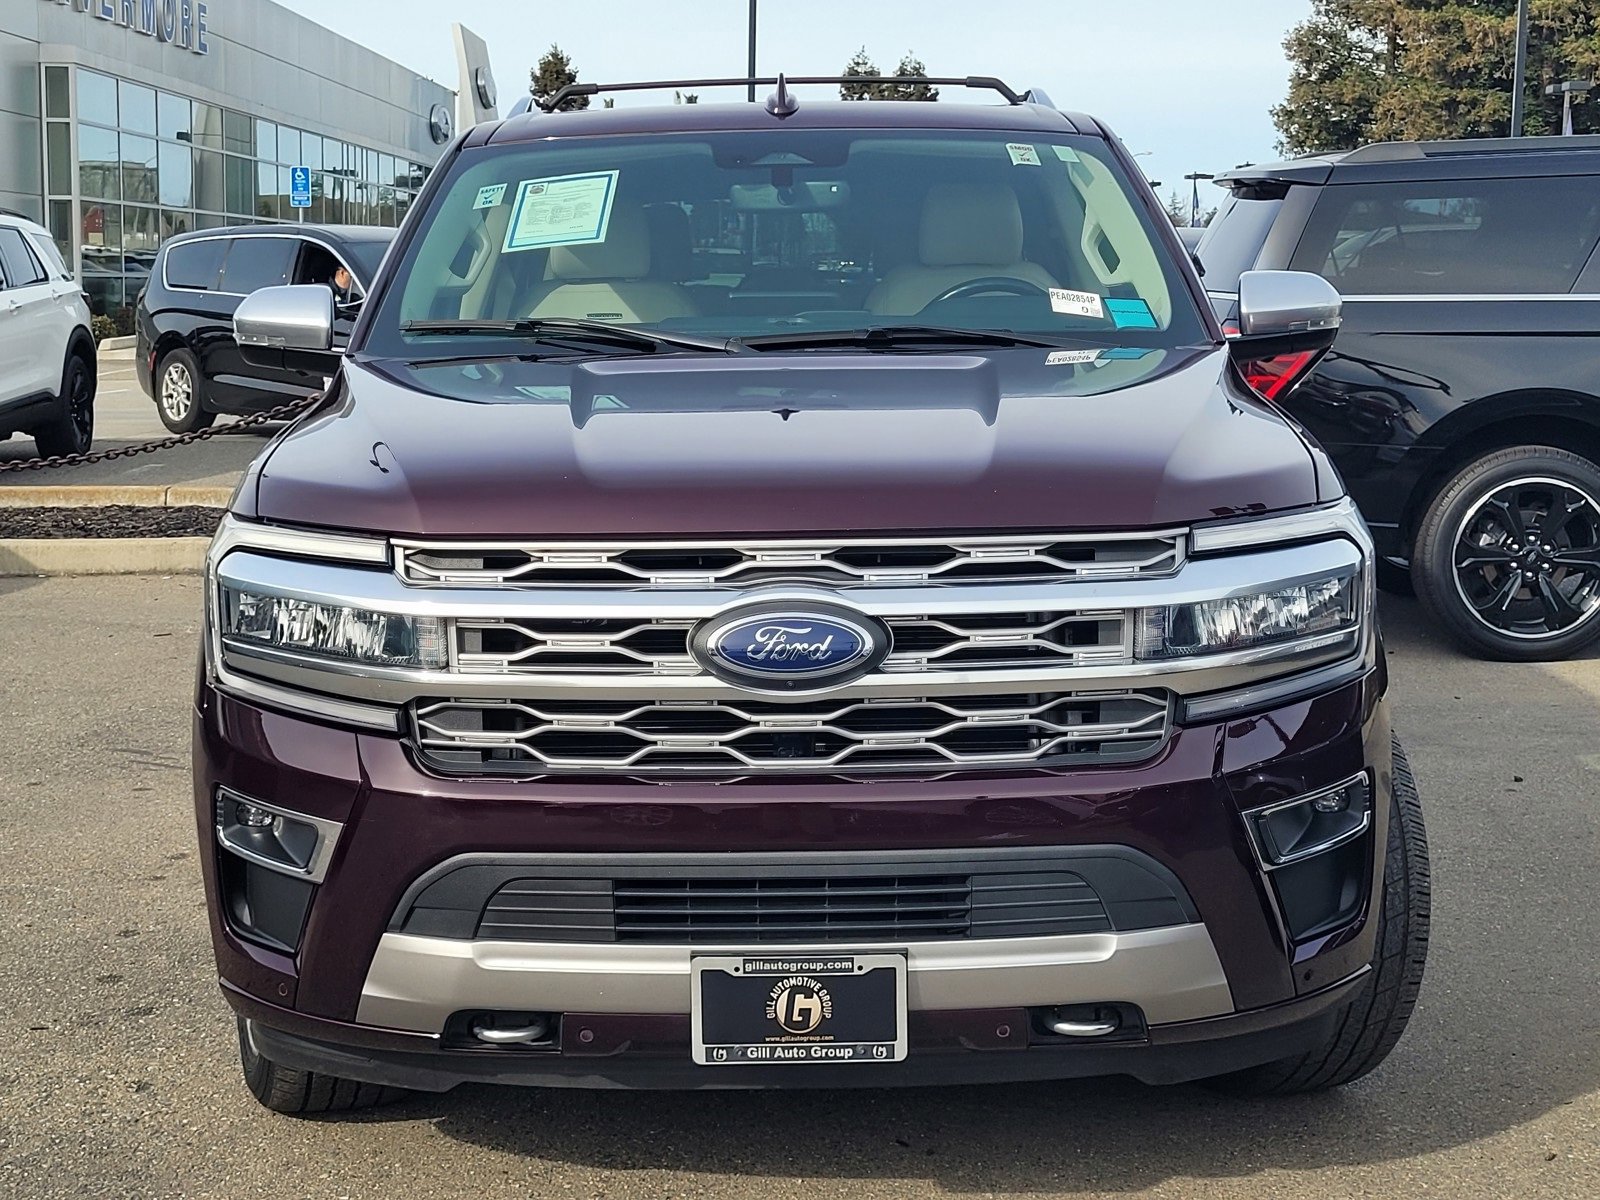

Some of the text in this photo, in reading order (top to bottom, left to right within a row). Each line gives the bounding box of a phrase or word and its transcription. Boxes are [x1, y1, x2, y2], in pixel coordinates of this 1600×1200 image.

[480, 187, 504, 195] SAFETY
[1050, 291, 1096, 304] PEA02854P
[746, 626, 834, 661] Ford
[745, 961, 852, 972] gillautogroup.com
[765, 976, 833, 1019] GILL AUTOMOTIVE GROUP
[747, 1047, 769, 1058] Gill
[774, 1047, 806, 1058] Auto
[811, 1047, 853, 1060] Group
